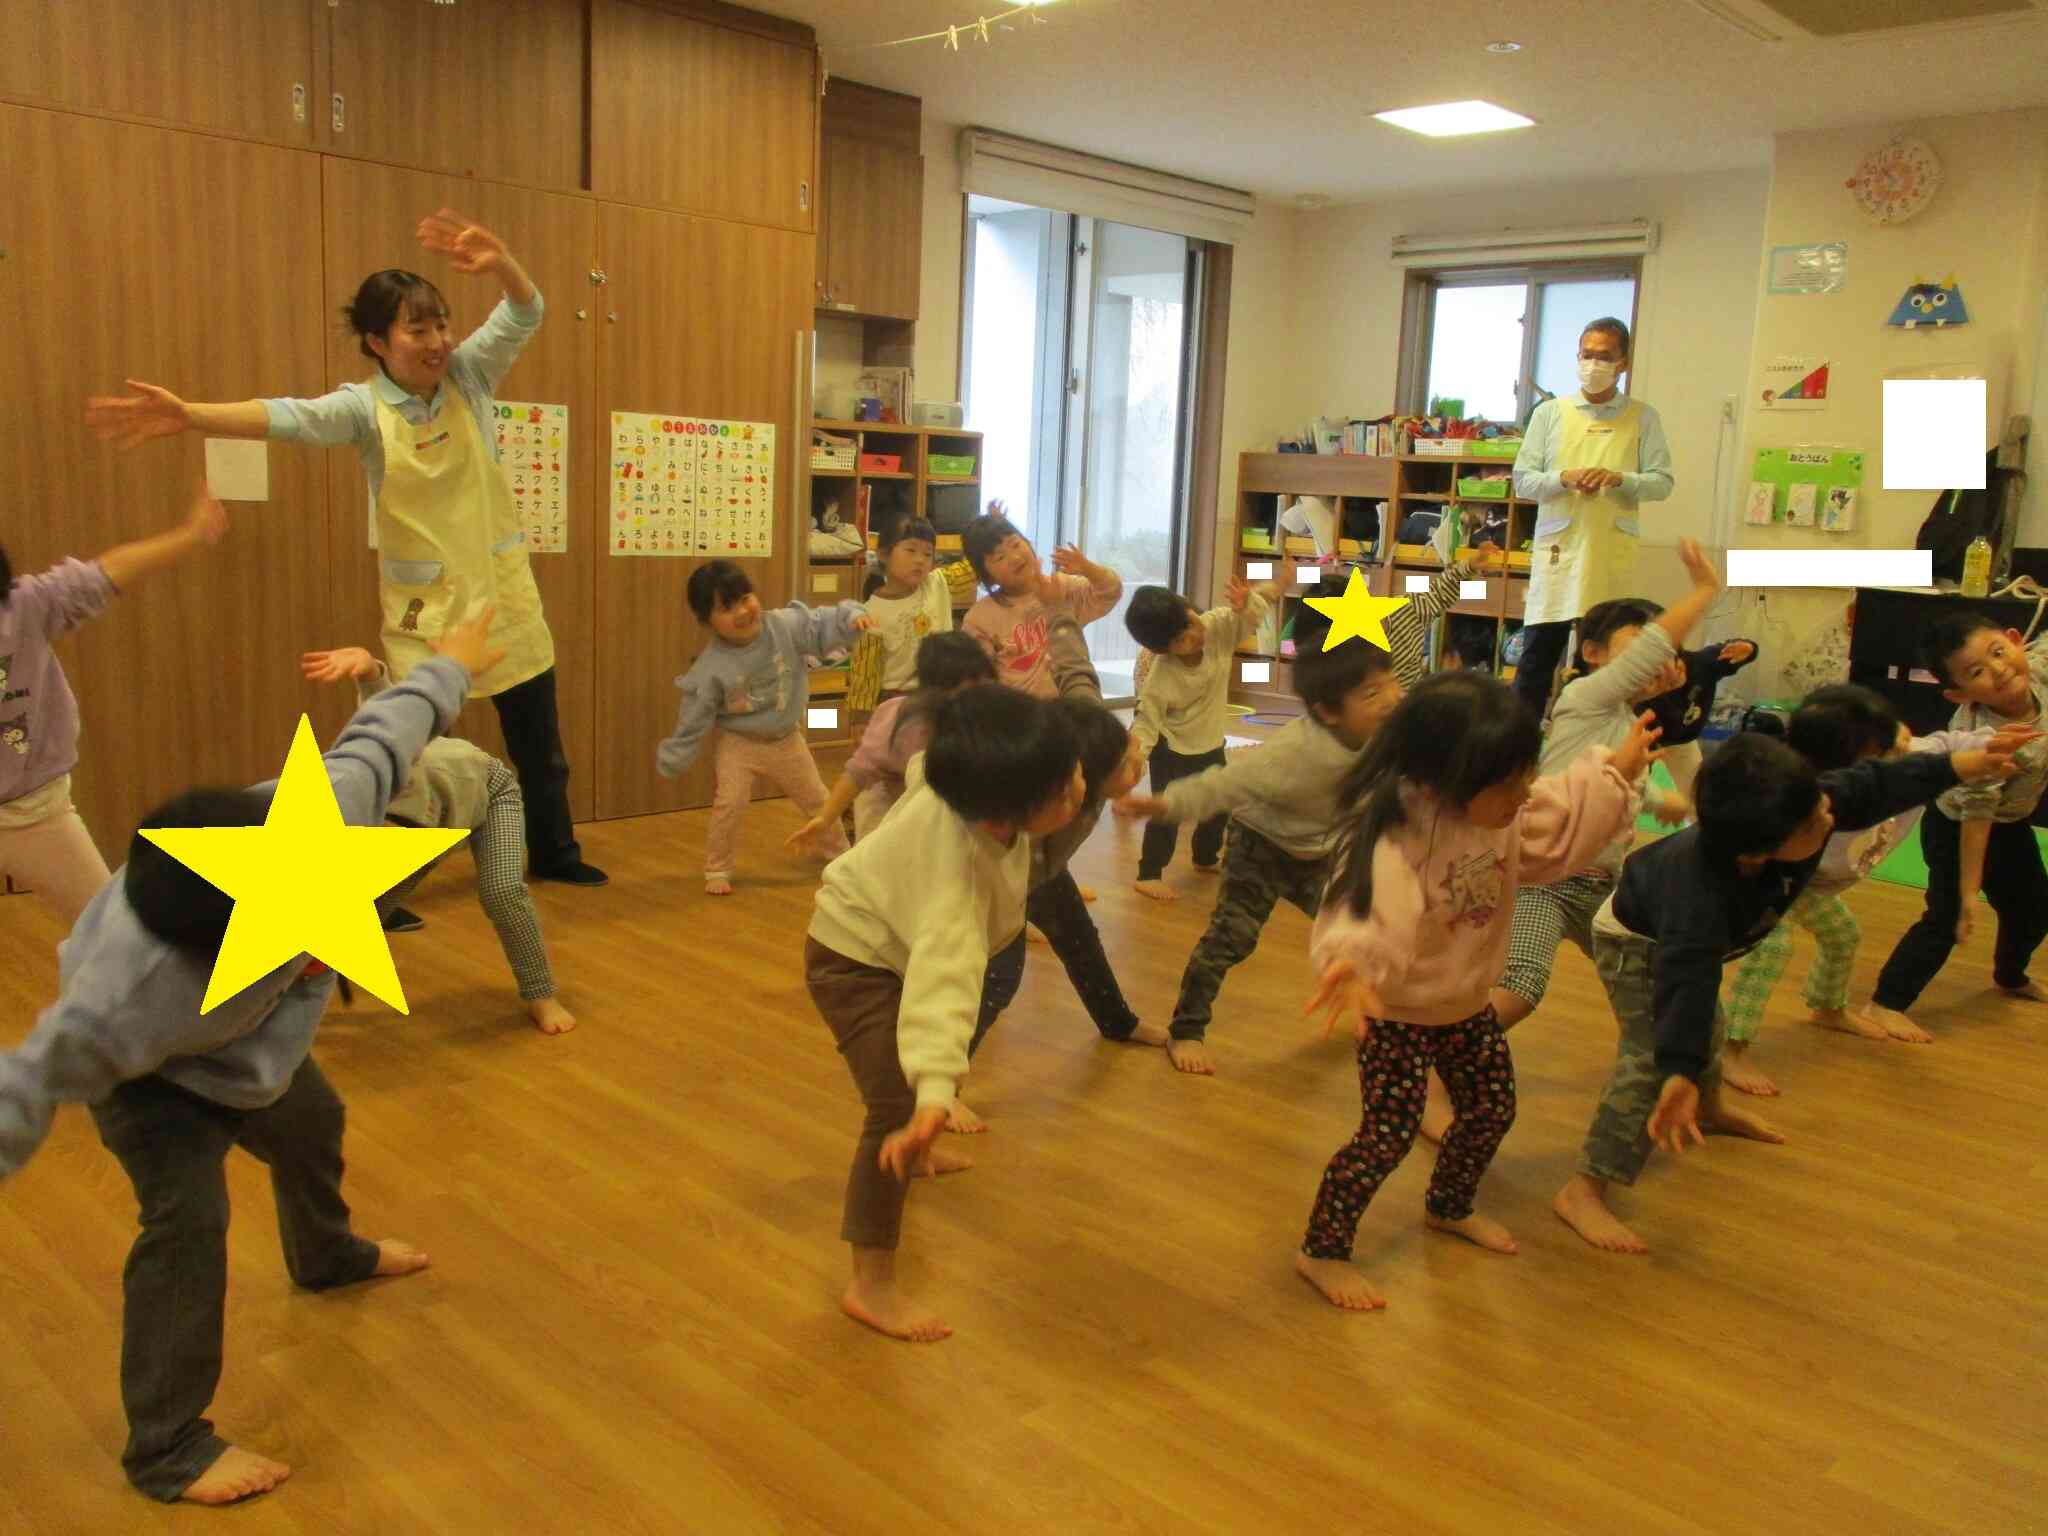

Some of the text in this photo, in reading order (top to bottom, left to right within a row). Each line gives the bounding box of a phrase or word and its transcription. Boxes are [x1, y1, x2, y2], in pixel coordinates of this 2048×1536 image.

[552, 427, 560, 436] ア
[636, 436, 643, 445] ら
[652, 436, 660, 445] や
[515, 450, 524, 459] シ
[552, 453, 559, 461] イ
[1790, 453, 1829, 464] おとうばん
[636, 460, 643, 469] り
[684, 462, 692, 471] ひ
[732, 465, 738, 473] し
[515, 475, 524, 484] ス
[668, 484, 675, 492] む
[730, 487, 737, 495] す
[533, 501, 542, 510] ケ
[715, 509, 722, 517] て
[533, 526, 541, 534] コ
[650, 530, 659, 539] よ
[715, 531, 722, 540] と
[744, 532, 751, 540] こ
